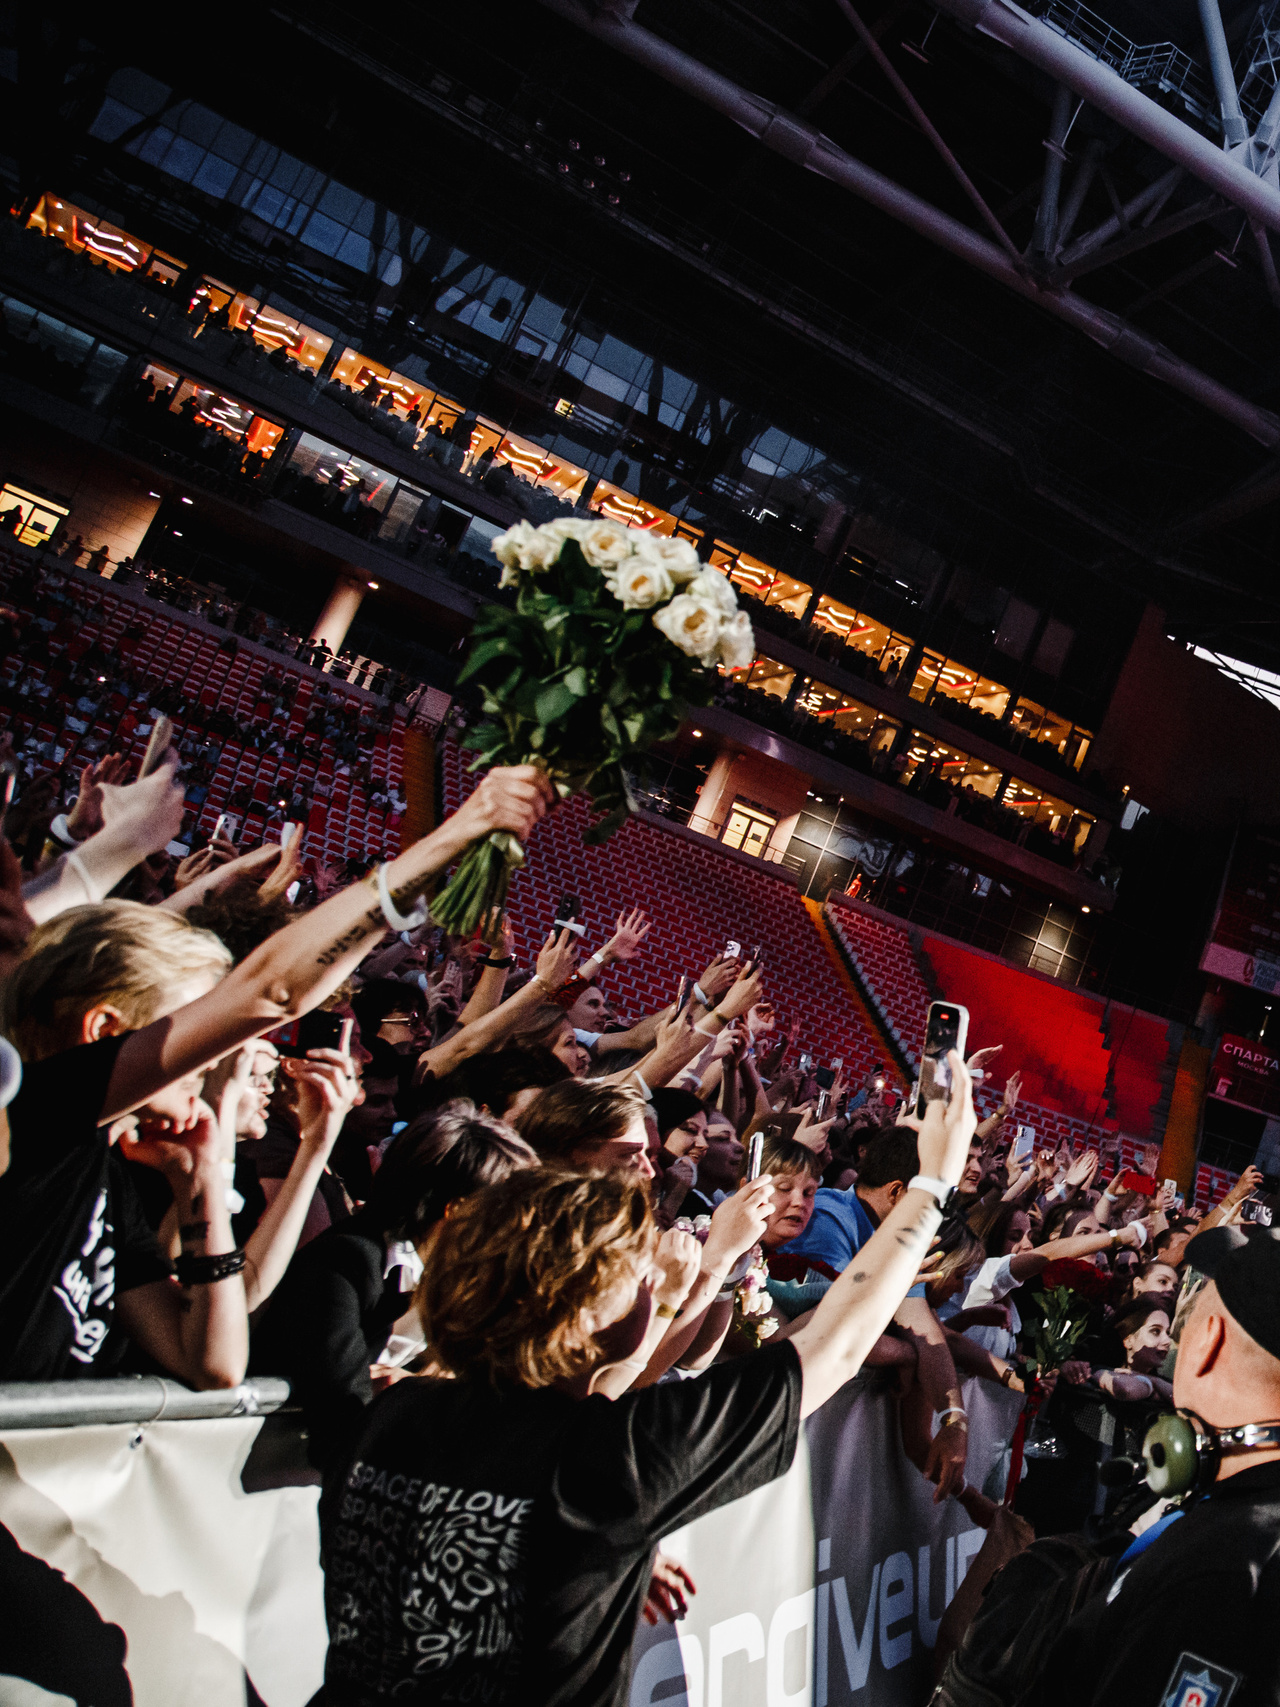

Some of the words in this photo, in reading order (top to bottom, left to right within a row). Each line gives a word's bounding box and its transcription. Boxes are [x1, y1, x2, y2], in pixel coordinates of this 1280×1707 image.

[1237, 1061, 1270, 1076] МОСКВА
[347, 1460, 422, 1508] SPACE
[417, 1482, 450, 1515] OF
[445, 1488, 535, 1524] LOVE
